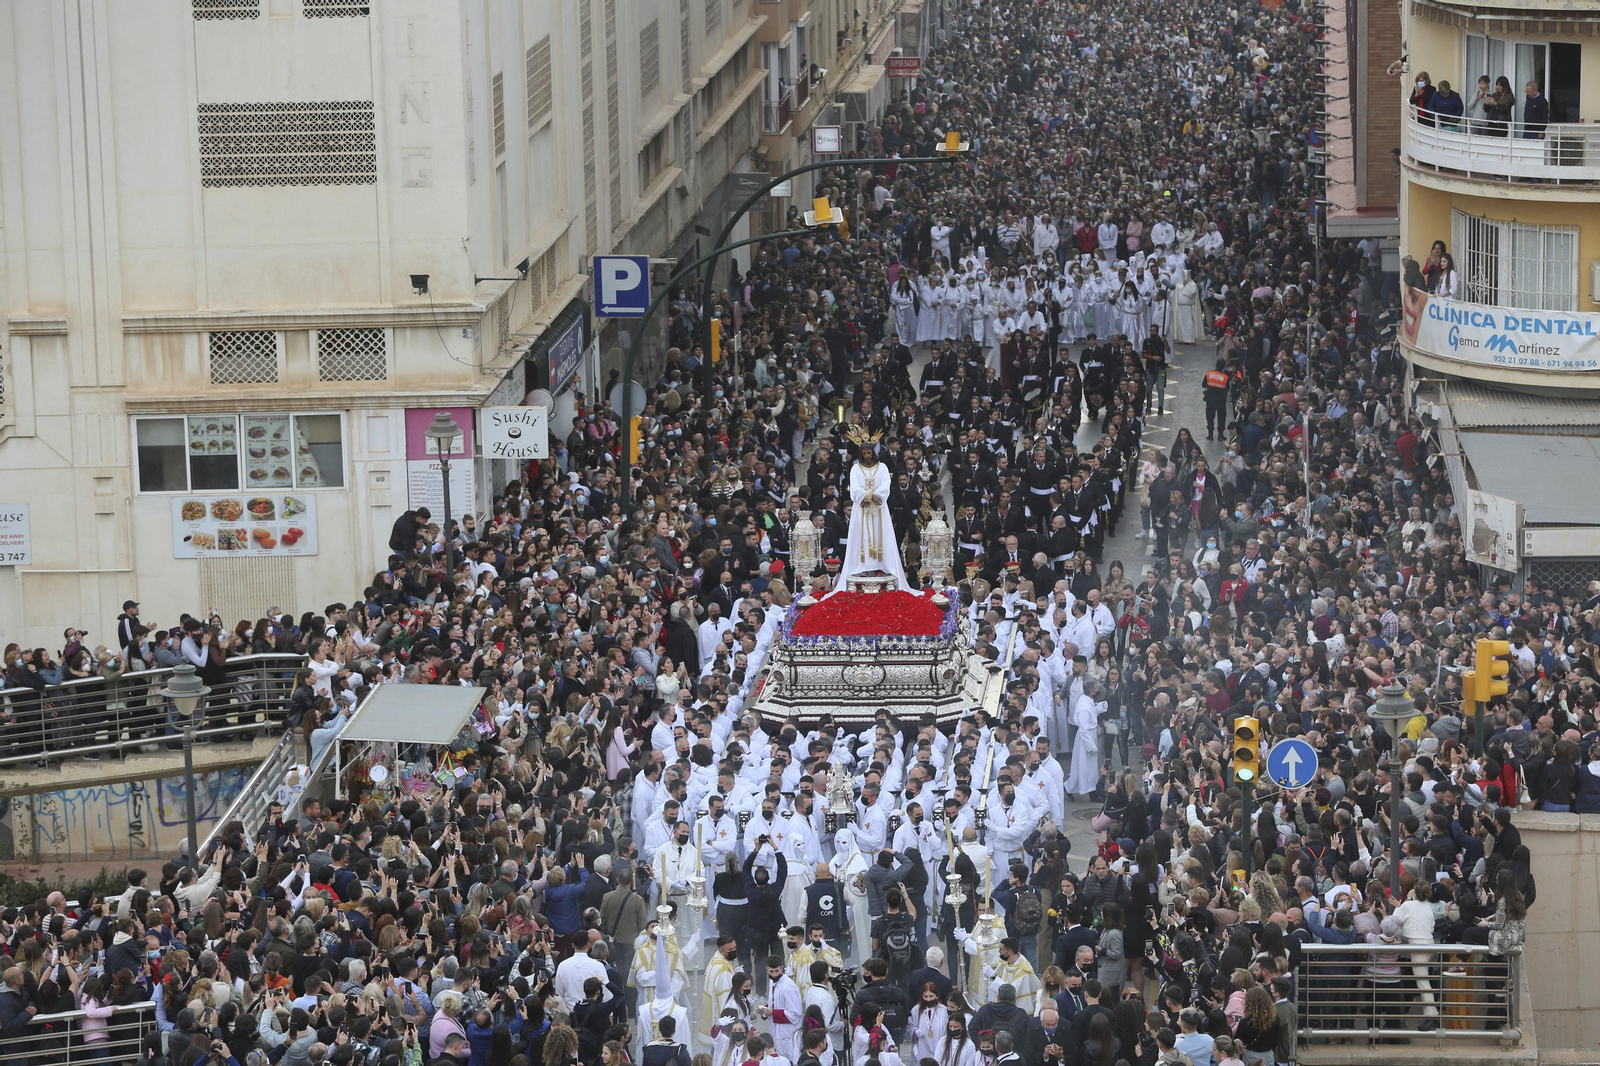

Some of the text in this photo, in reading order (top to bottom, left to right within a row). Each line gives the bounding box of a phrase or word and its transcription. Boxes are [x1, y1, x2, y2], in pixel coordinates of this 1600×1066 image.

[601, 259, 641, 304] P
[1429, 303, 1597, 336] CLÍNICA DENTAL
[1448, 325, 1560, 355] Gema Martínez
[1493, 355, 1506, 363] 952
[492, 409, 540, 427] Sushi
[492, 442, 540, 458] House
[8, 553, 25, 561] 747
